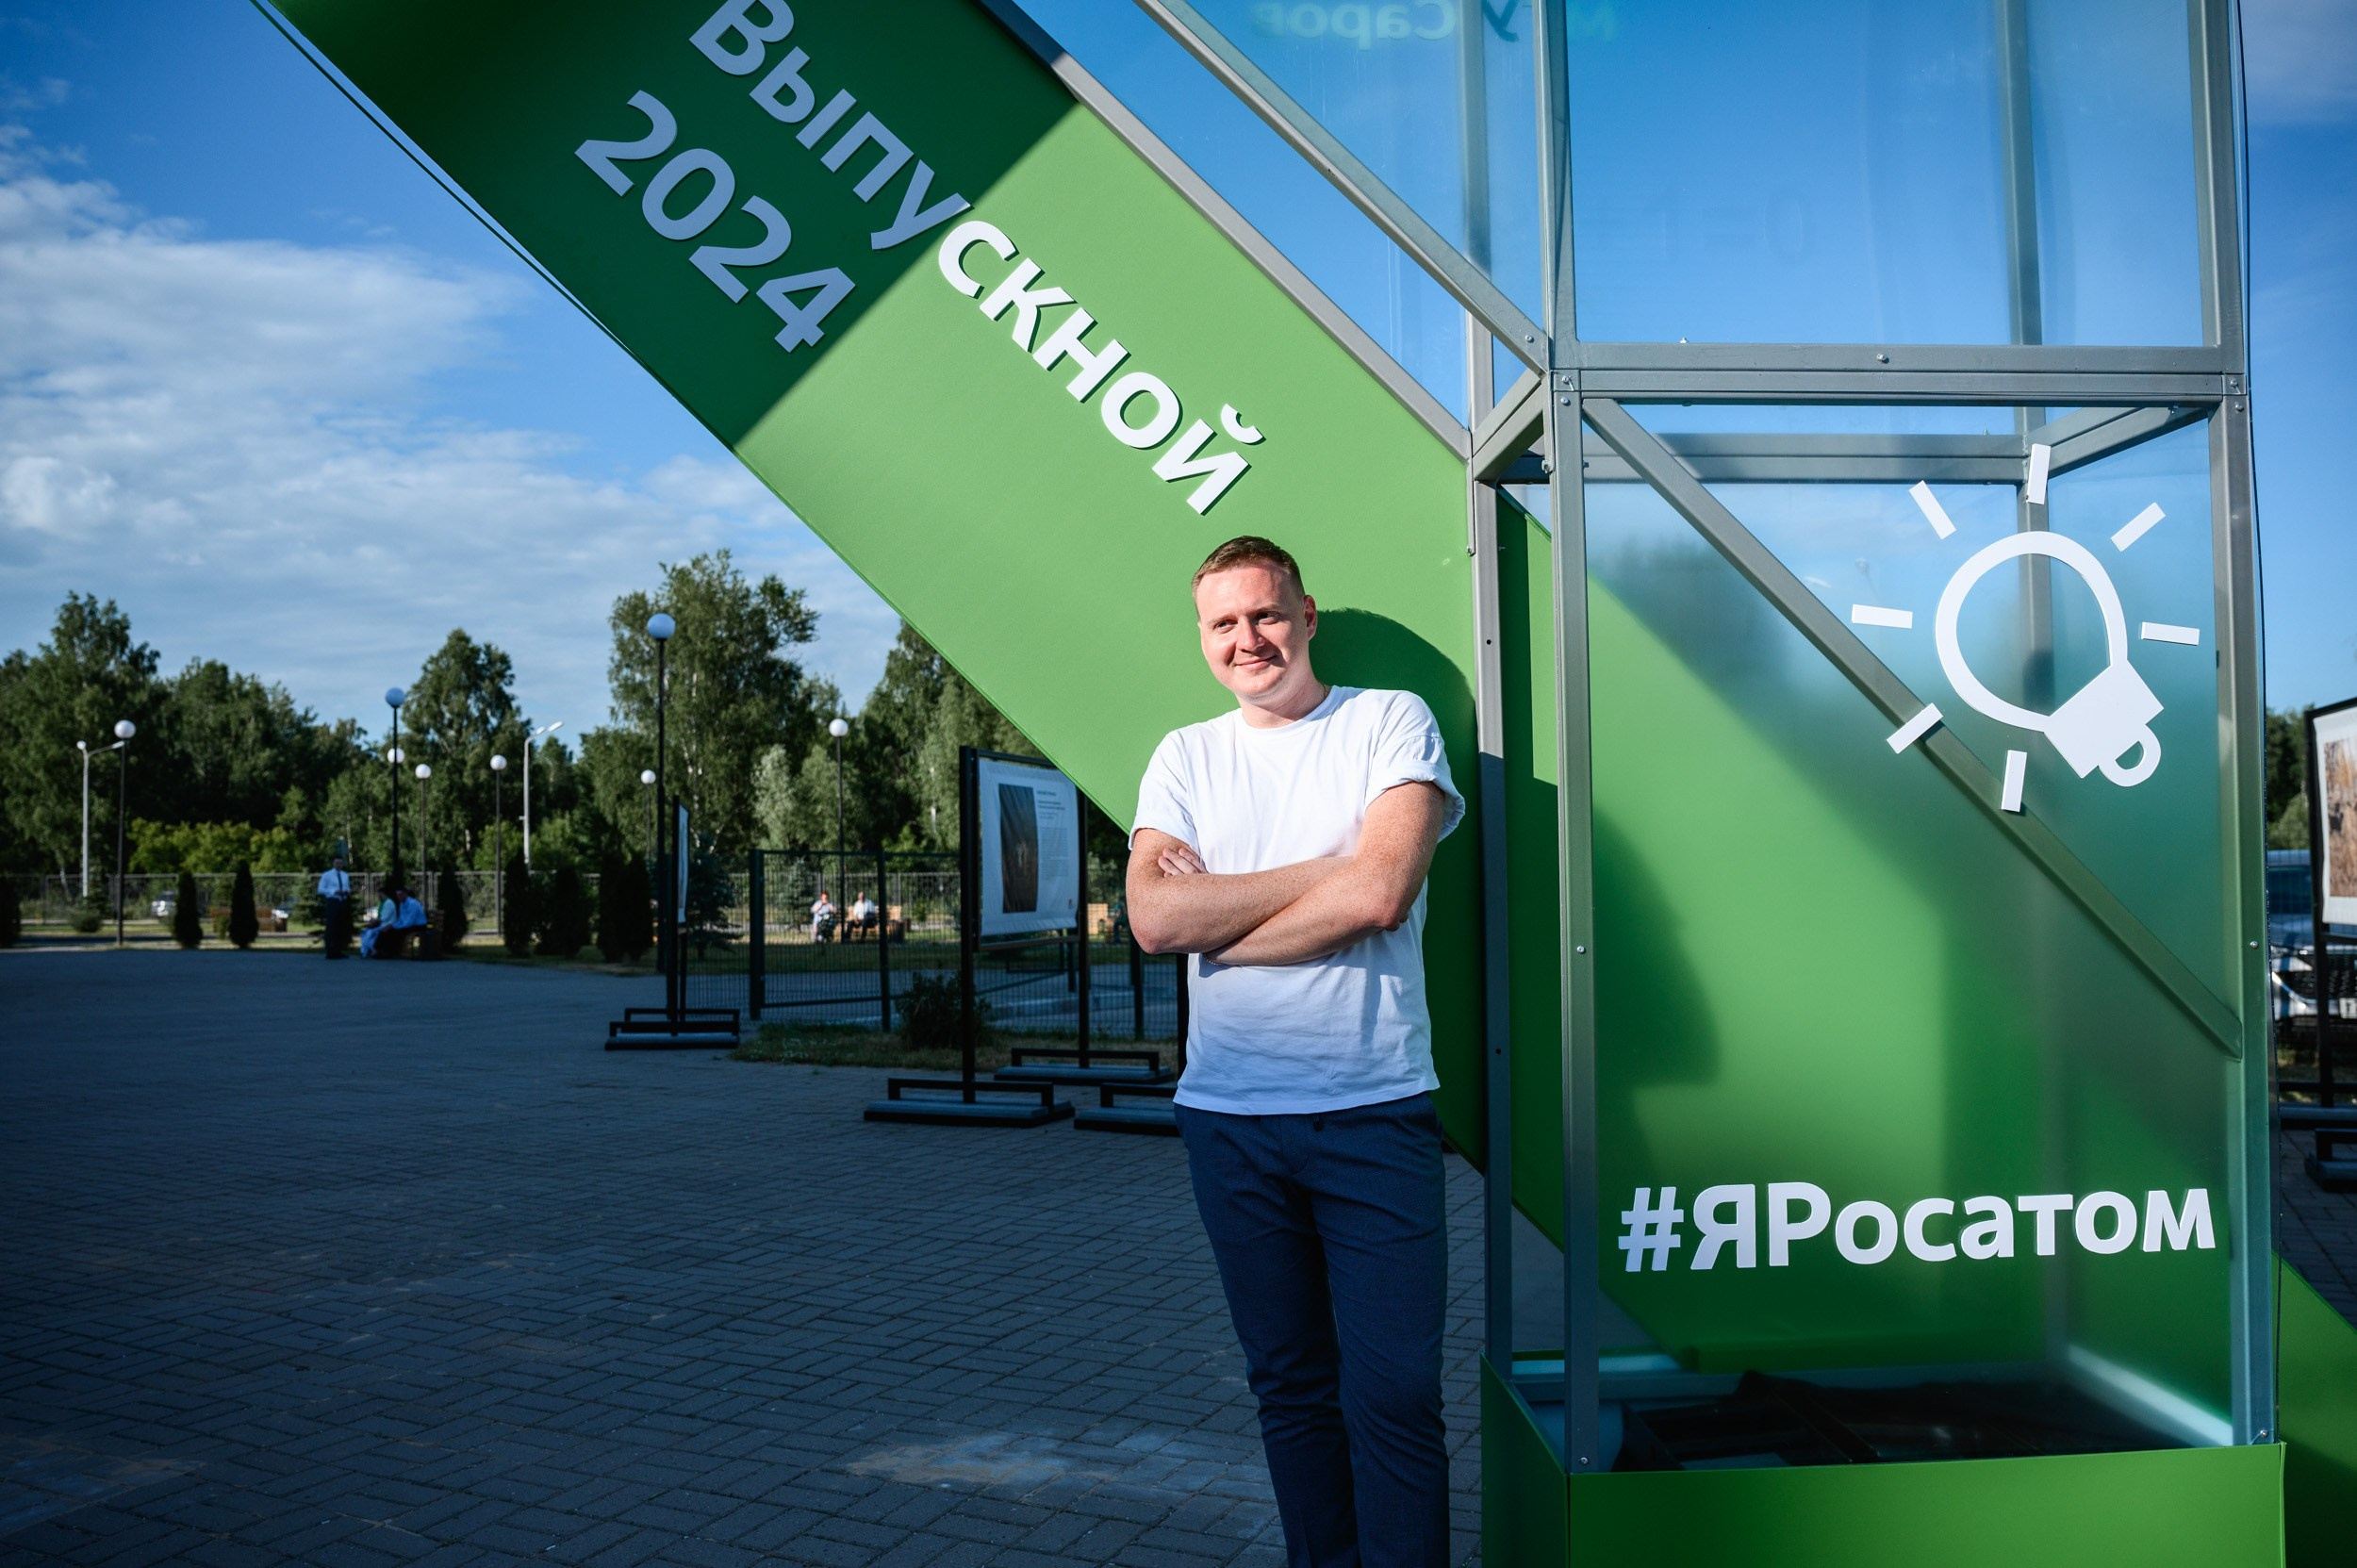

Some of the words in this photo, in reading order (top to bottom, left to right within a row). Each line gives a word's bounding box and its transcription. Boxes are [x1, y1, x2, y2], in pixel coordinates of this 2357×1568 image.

[574, 91, 856, 353] 2024
[688, 0, 1263, 515] Выпускной
[1618, 1181, 2217, 1273] #ЯРосатом
